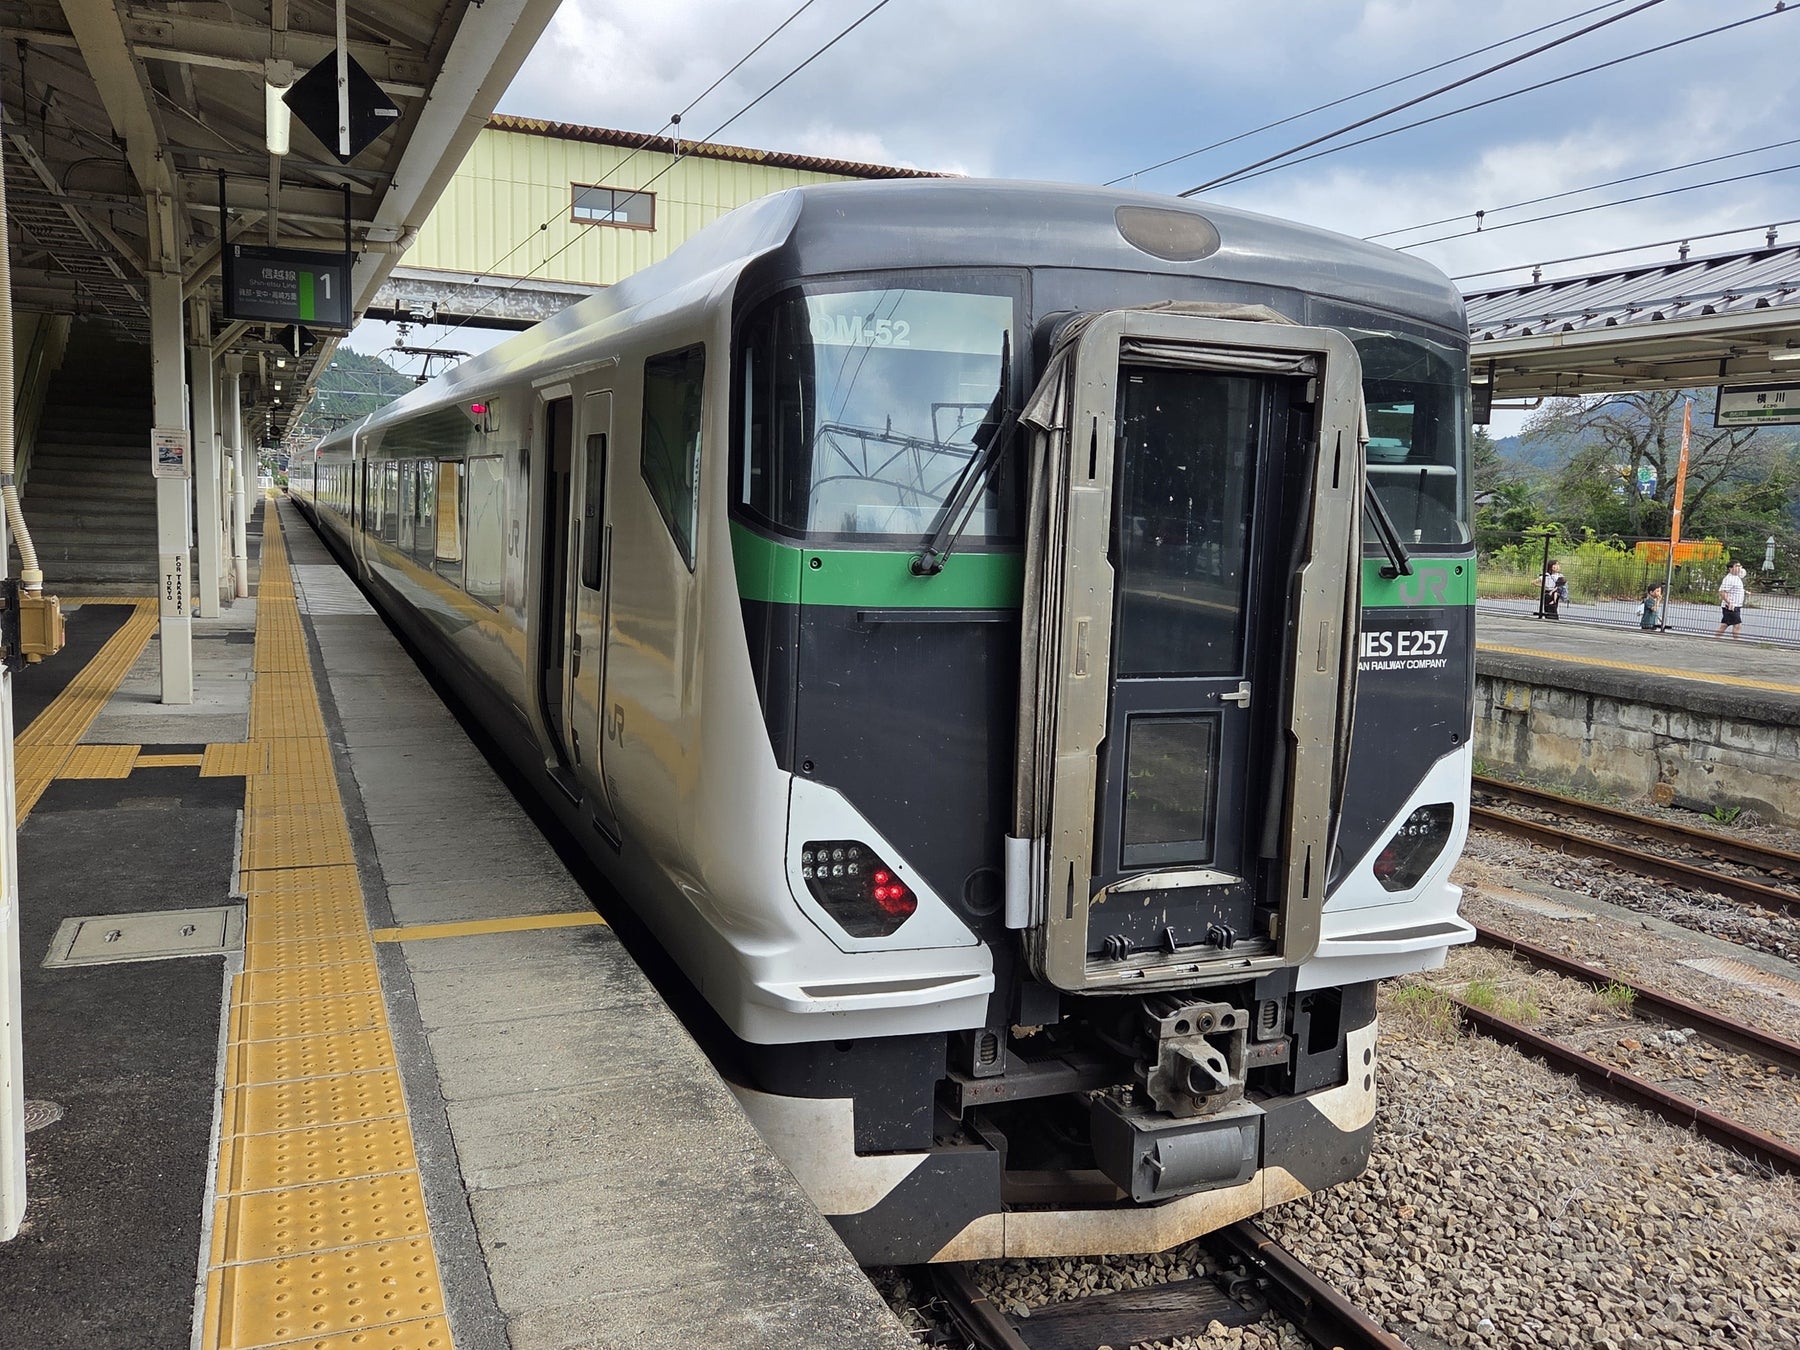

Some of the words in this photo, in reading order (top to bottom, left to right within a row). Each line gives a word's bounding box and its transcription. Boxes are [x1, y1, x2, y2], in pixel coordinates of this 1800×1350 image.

[319, 273, 331, 300] 1
[507, 519, 520, 559] JR
[1398, 567, 1448, 605] JR
[1360, 631, 1393, 658] IES
[1397, 630, 1449, 656] E257
[1371, 660, 1406, 671] RAILWAY
[1406, 658, 1448, 669] COMPANY
[607, 702, 625, 749] JR
